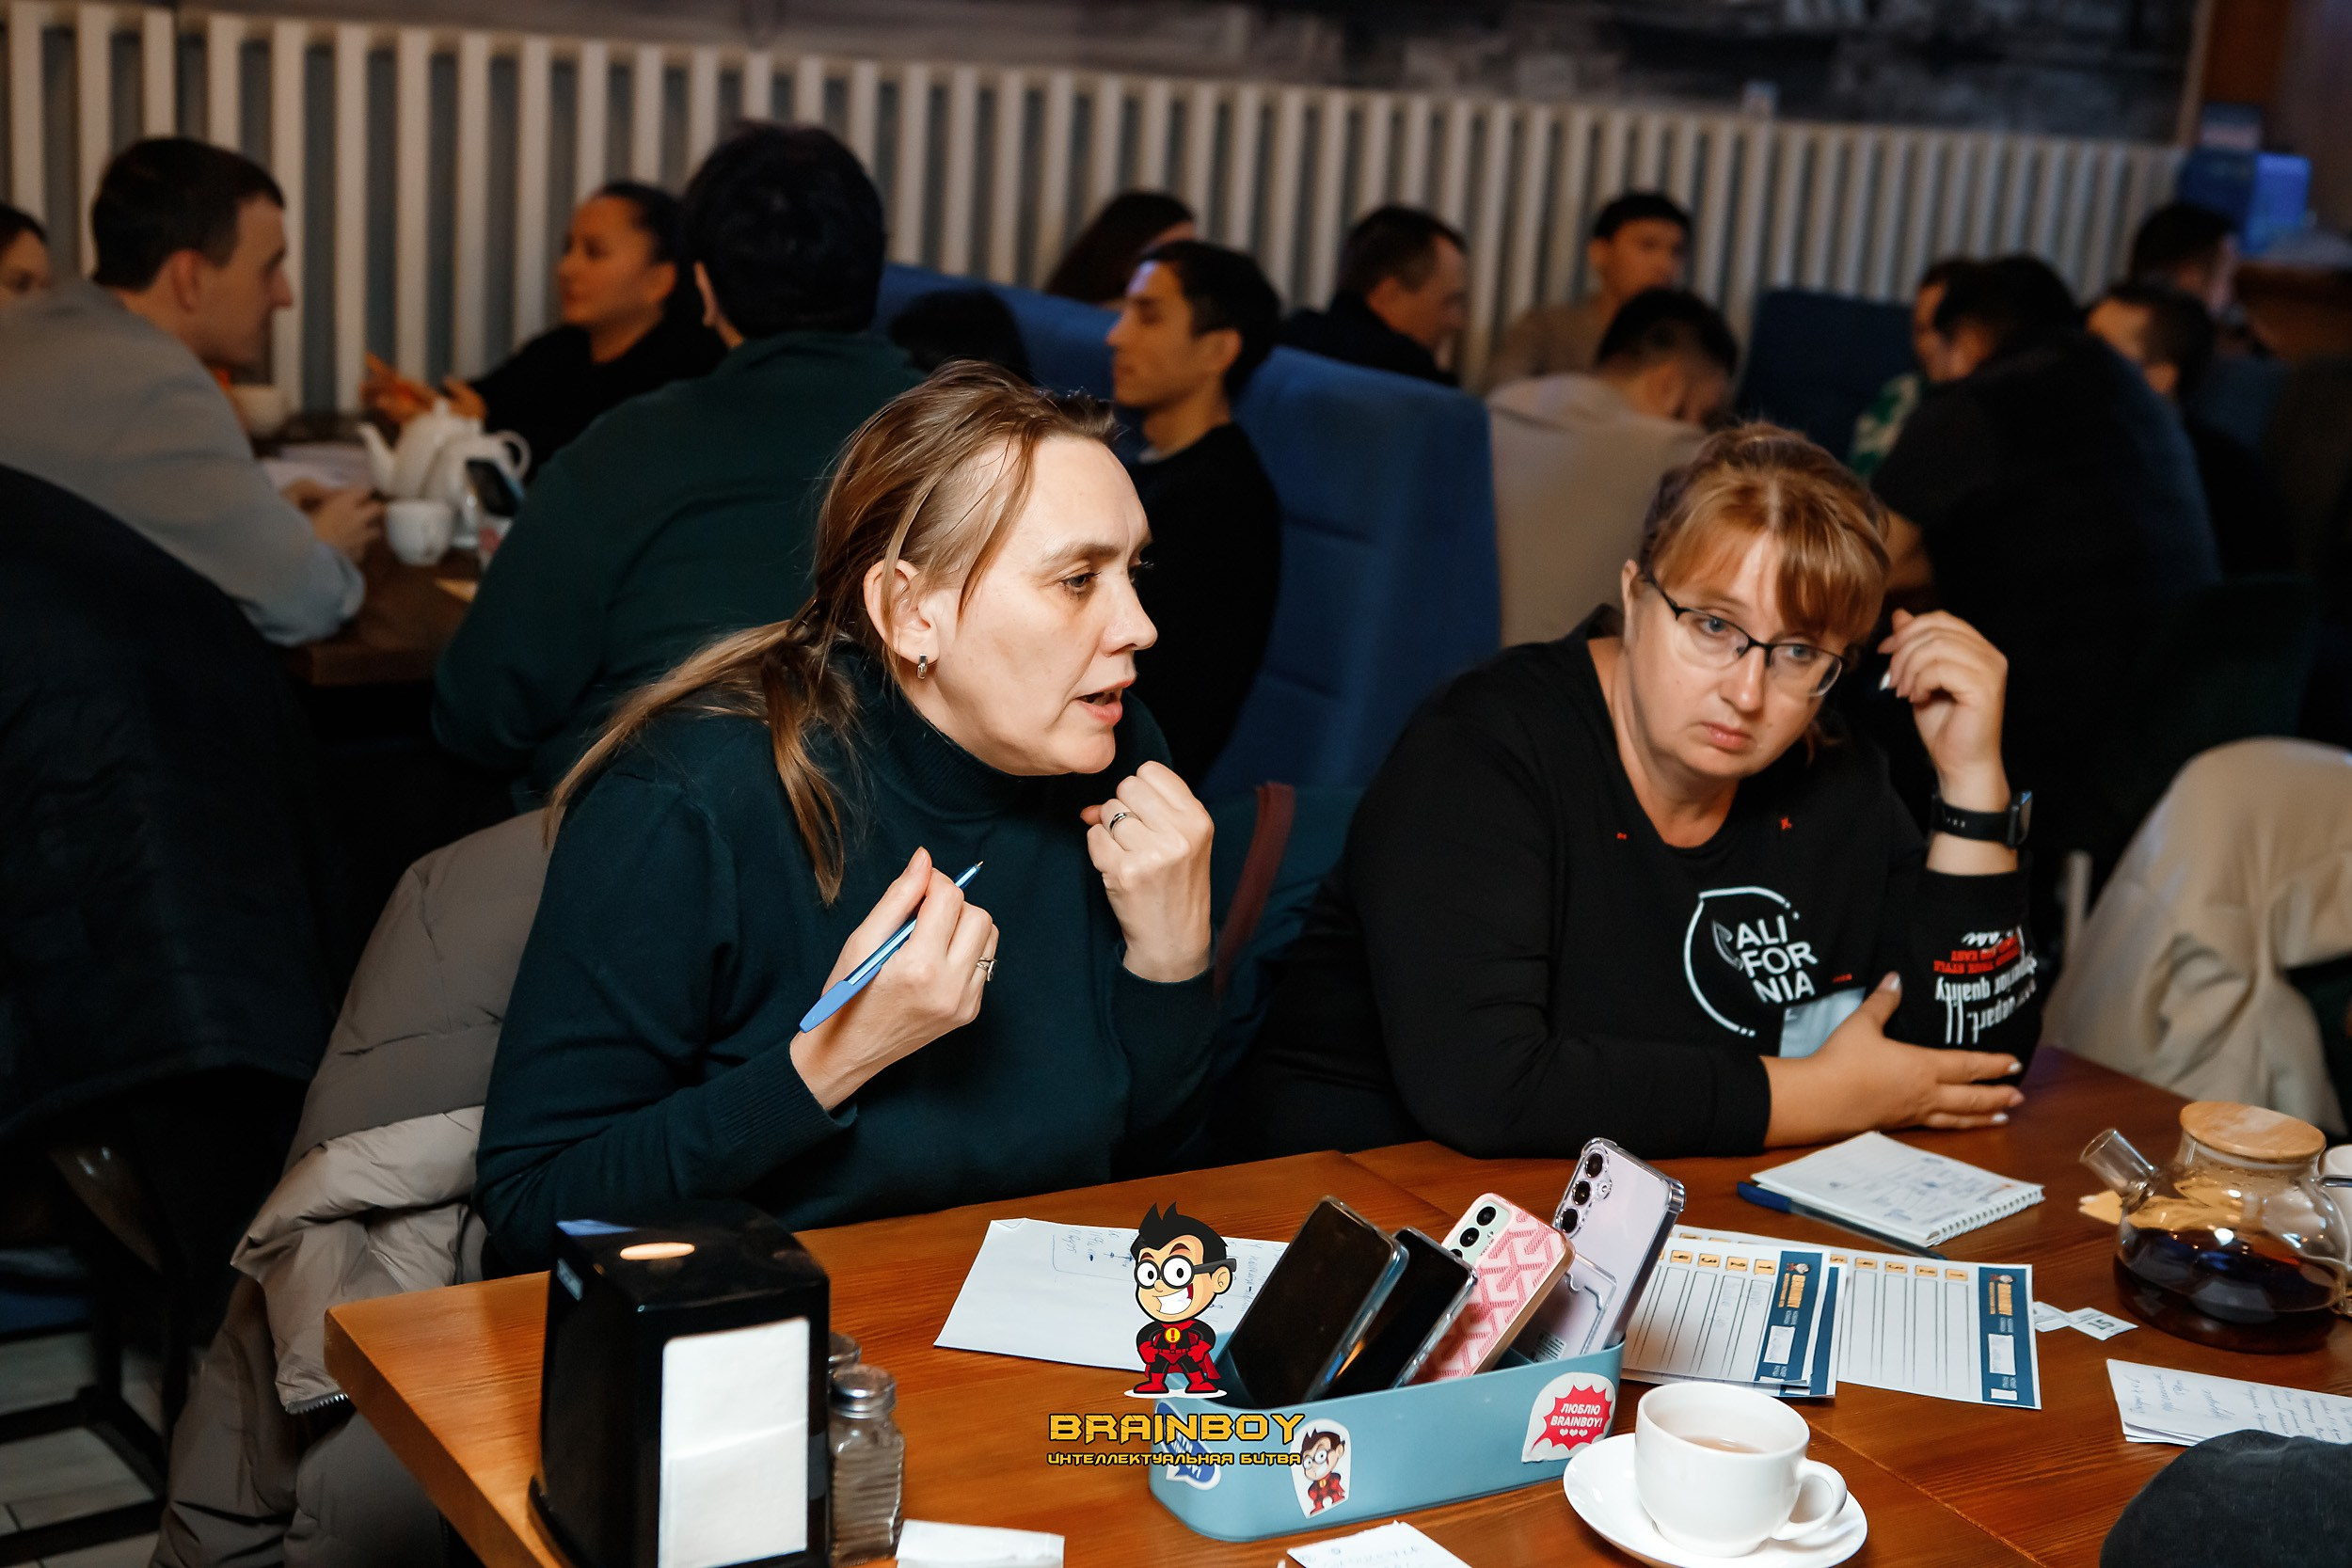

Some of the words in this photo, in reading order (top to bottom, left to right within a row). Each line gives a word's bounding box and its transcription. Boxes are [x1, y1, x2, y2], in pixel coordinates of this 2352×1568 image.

[1740, 941, 1819, 979] FOR
[1752, 970, 1816, 1005] NIA
[1934, 975, 1992, 1045] quality
[2088, 1319, 2115, 1330] 15
[1560, 1402, 1601, 1414] ЛЮБЛЮ
[1550, 1416, 1603, 1428] BRAINBOY!
